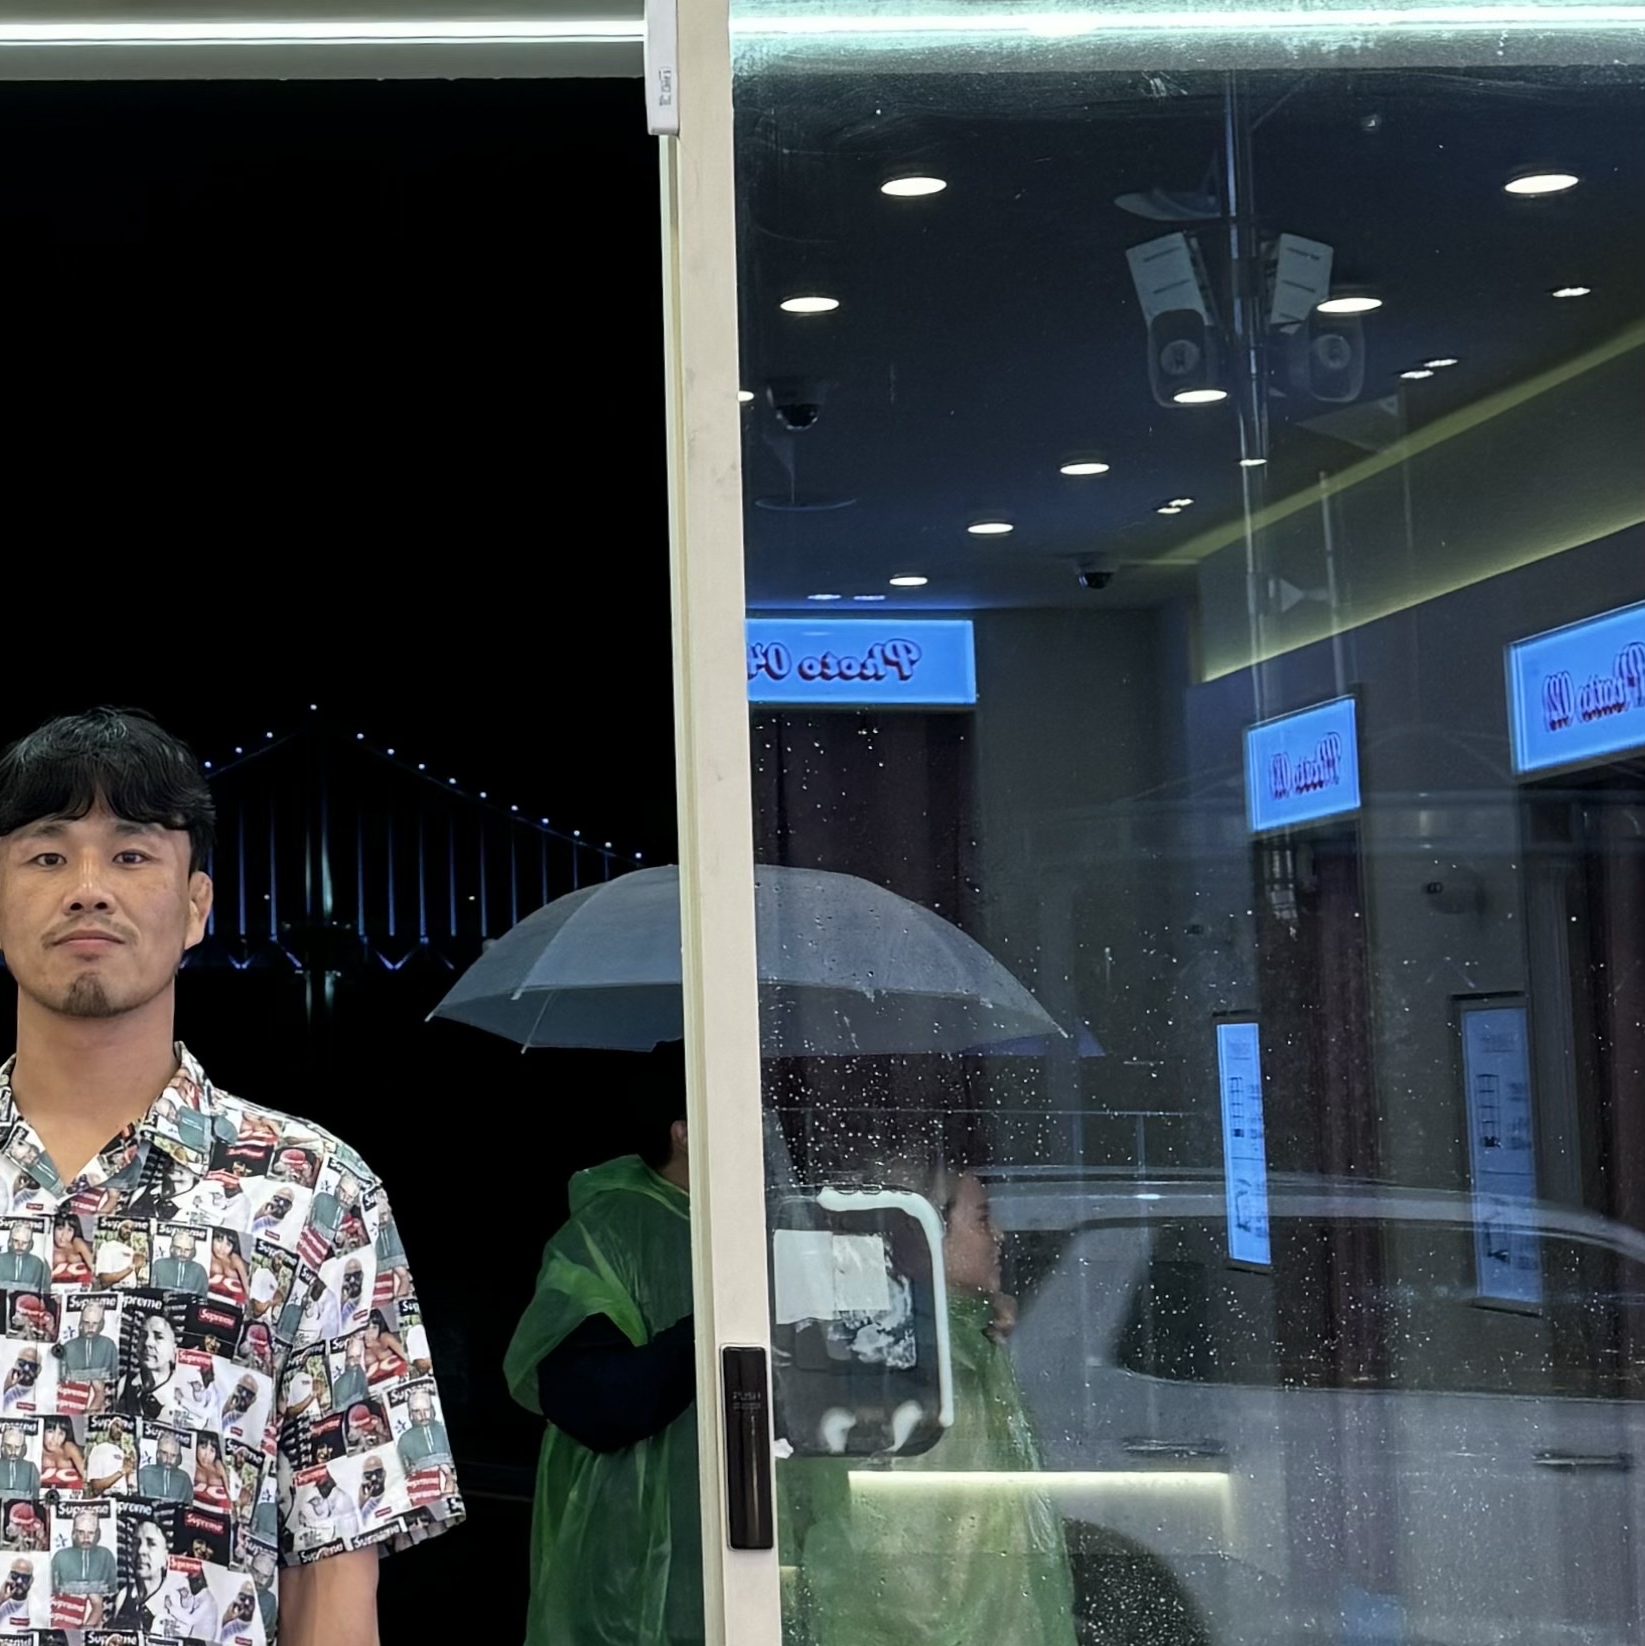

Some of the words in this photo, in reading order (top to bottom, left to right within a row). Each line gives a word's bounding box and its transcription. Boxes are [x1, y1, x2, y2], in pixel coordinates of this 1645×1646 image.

[101, 1218, 148, 1230] Supme
[91, 1416, 134, 1429] Supme
[88, 1632, 137, 1645] Supme
